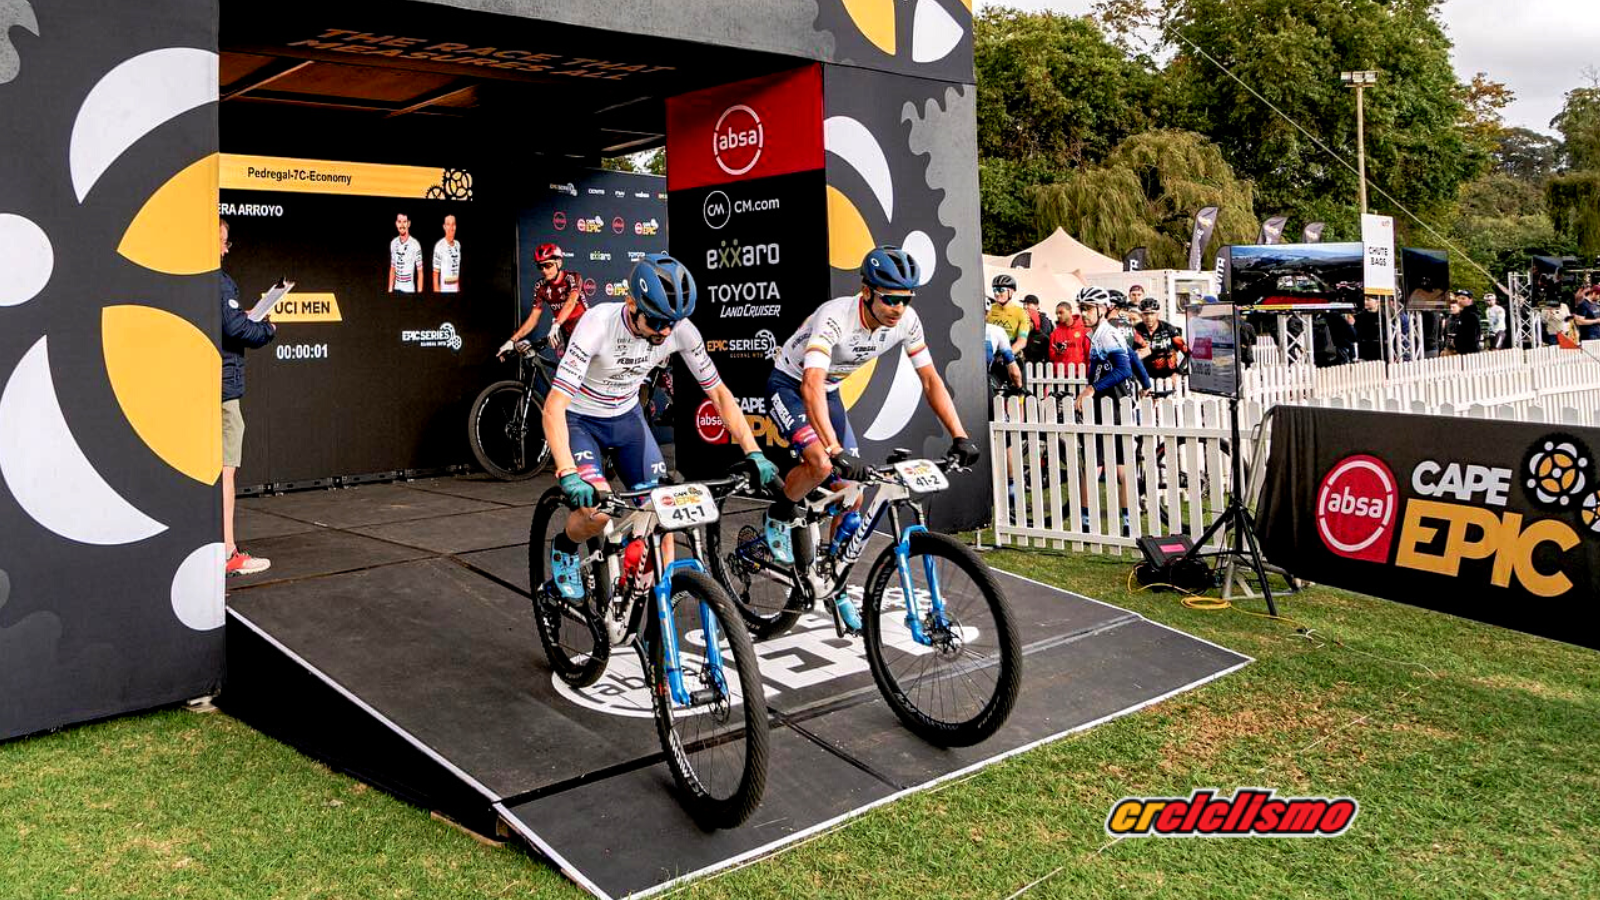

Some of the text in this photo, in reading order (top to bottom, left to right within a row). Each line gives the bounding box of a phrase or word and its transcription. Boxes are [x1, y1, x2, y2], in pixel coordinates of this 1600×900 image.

[317, 28, 677, 73] THE RACE THAT
[287, 39, 630, 80] MEASURES ALL
[719, 126, 758, 150] absa
[247, 167, 352, 185] Pedregal-7C-Economy
[238, 203, 284, 217] ARROYO
[734, 198, 780, 213] CM.com
[706, 238, 780, 270] exxaro
[1369, 246, 1388, 256] CHUTE
[707, 281, 781, 303] TOYOTA
[274, 301, 330, 314] UCI MEN
[276, 344, 328, 359] 00:00:01
[706, 339, 769, 352] EPIC SERIES
[575, 450, 594, 461] 7C
[651, 461, 667, 474] 7C
[916, 474, 940, 486] 41-2
[1411, 460, 1513, 506] CAPE
[1328, 486, 1384, 518] absa
[672, 505, 705, 520] 41-1
[1395, 498, 1581, 597] EPIC
